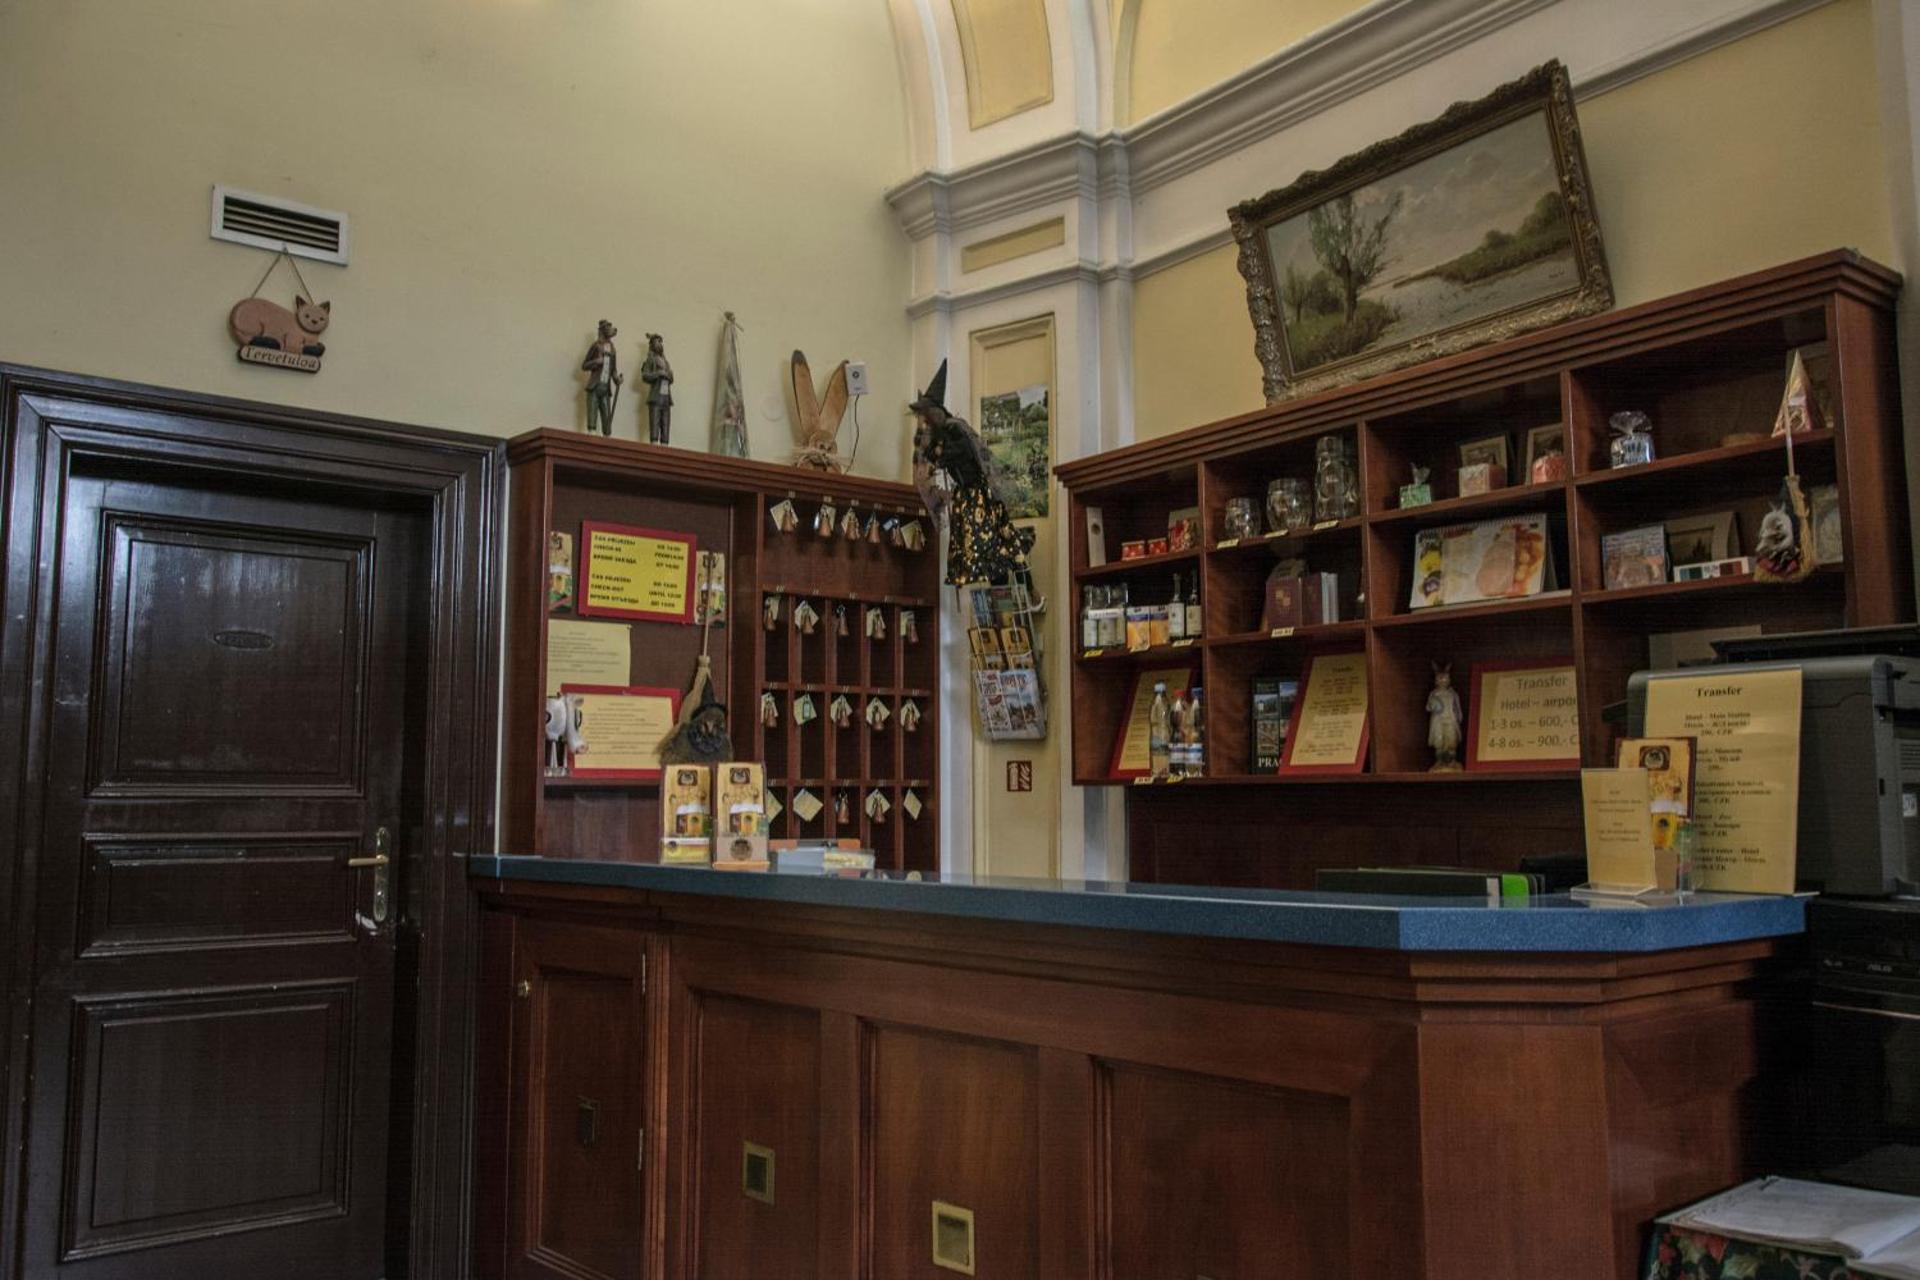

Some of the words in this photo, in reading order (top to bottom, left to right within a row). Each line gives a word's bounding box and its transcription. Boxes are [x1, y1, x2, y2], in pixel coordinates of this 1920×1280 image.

[1516, 676, 1569, 690] Transfer
[1696, 685, 1743, 698] Transfer
[1500, 697, 1530, 711] Hotel
